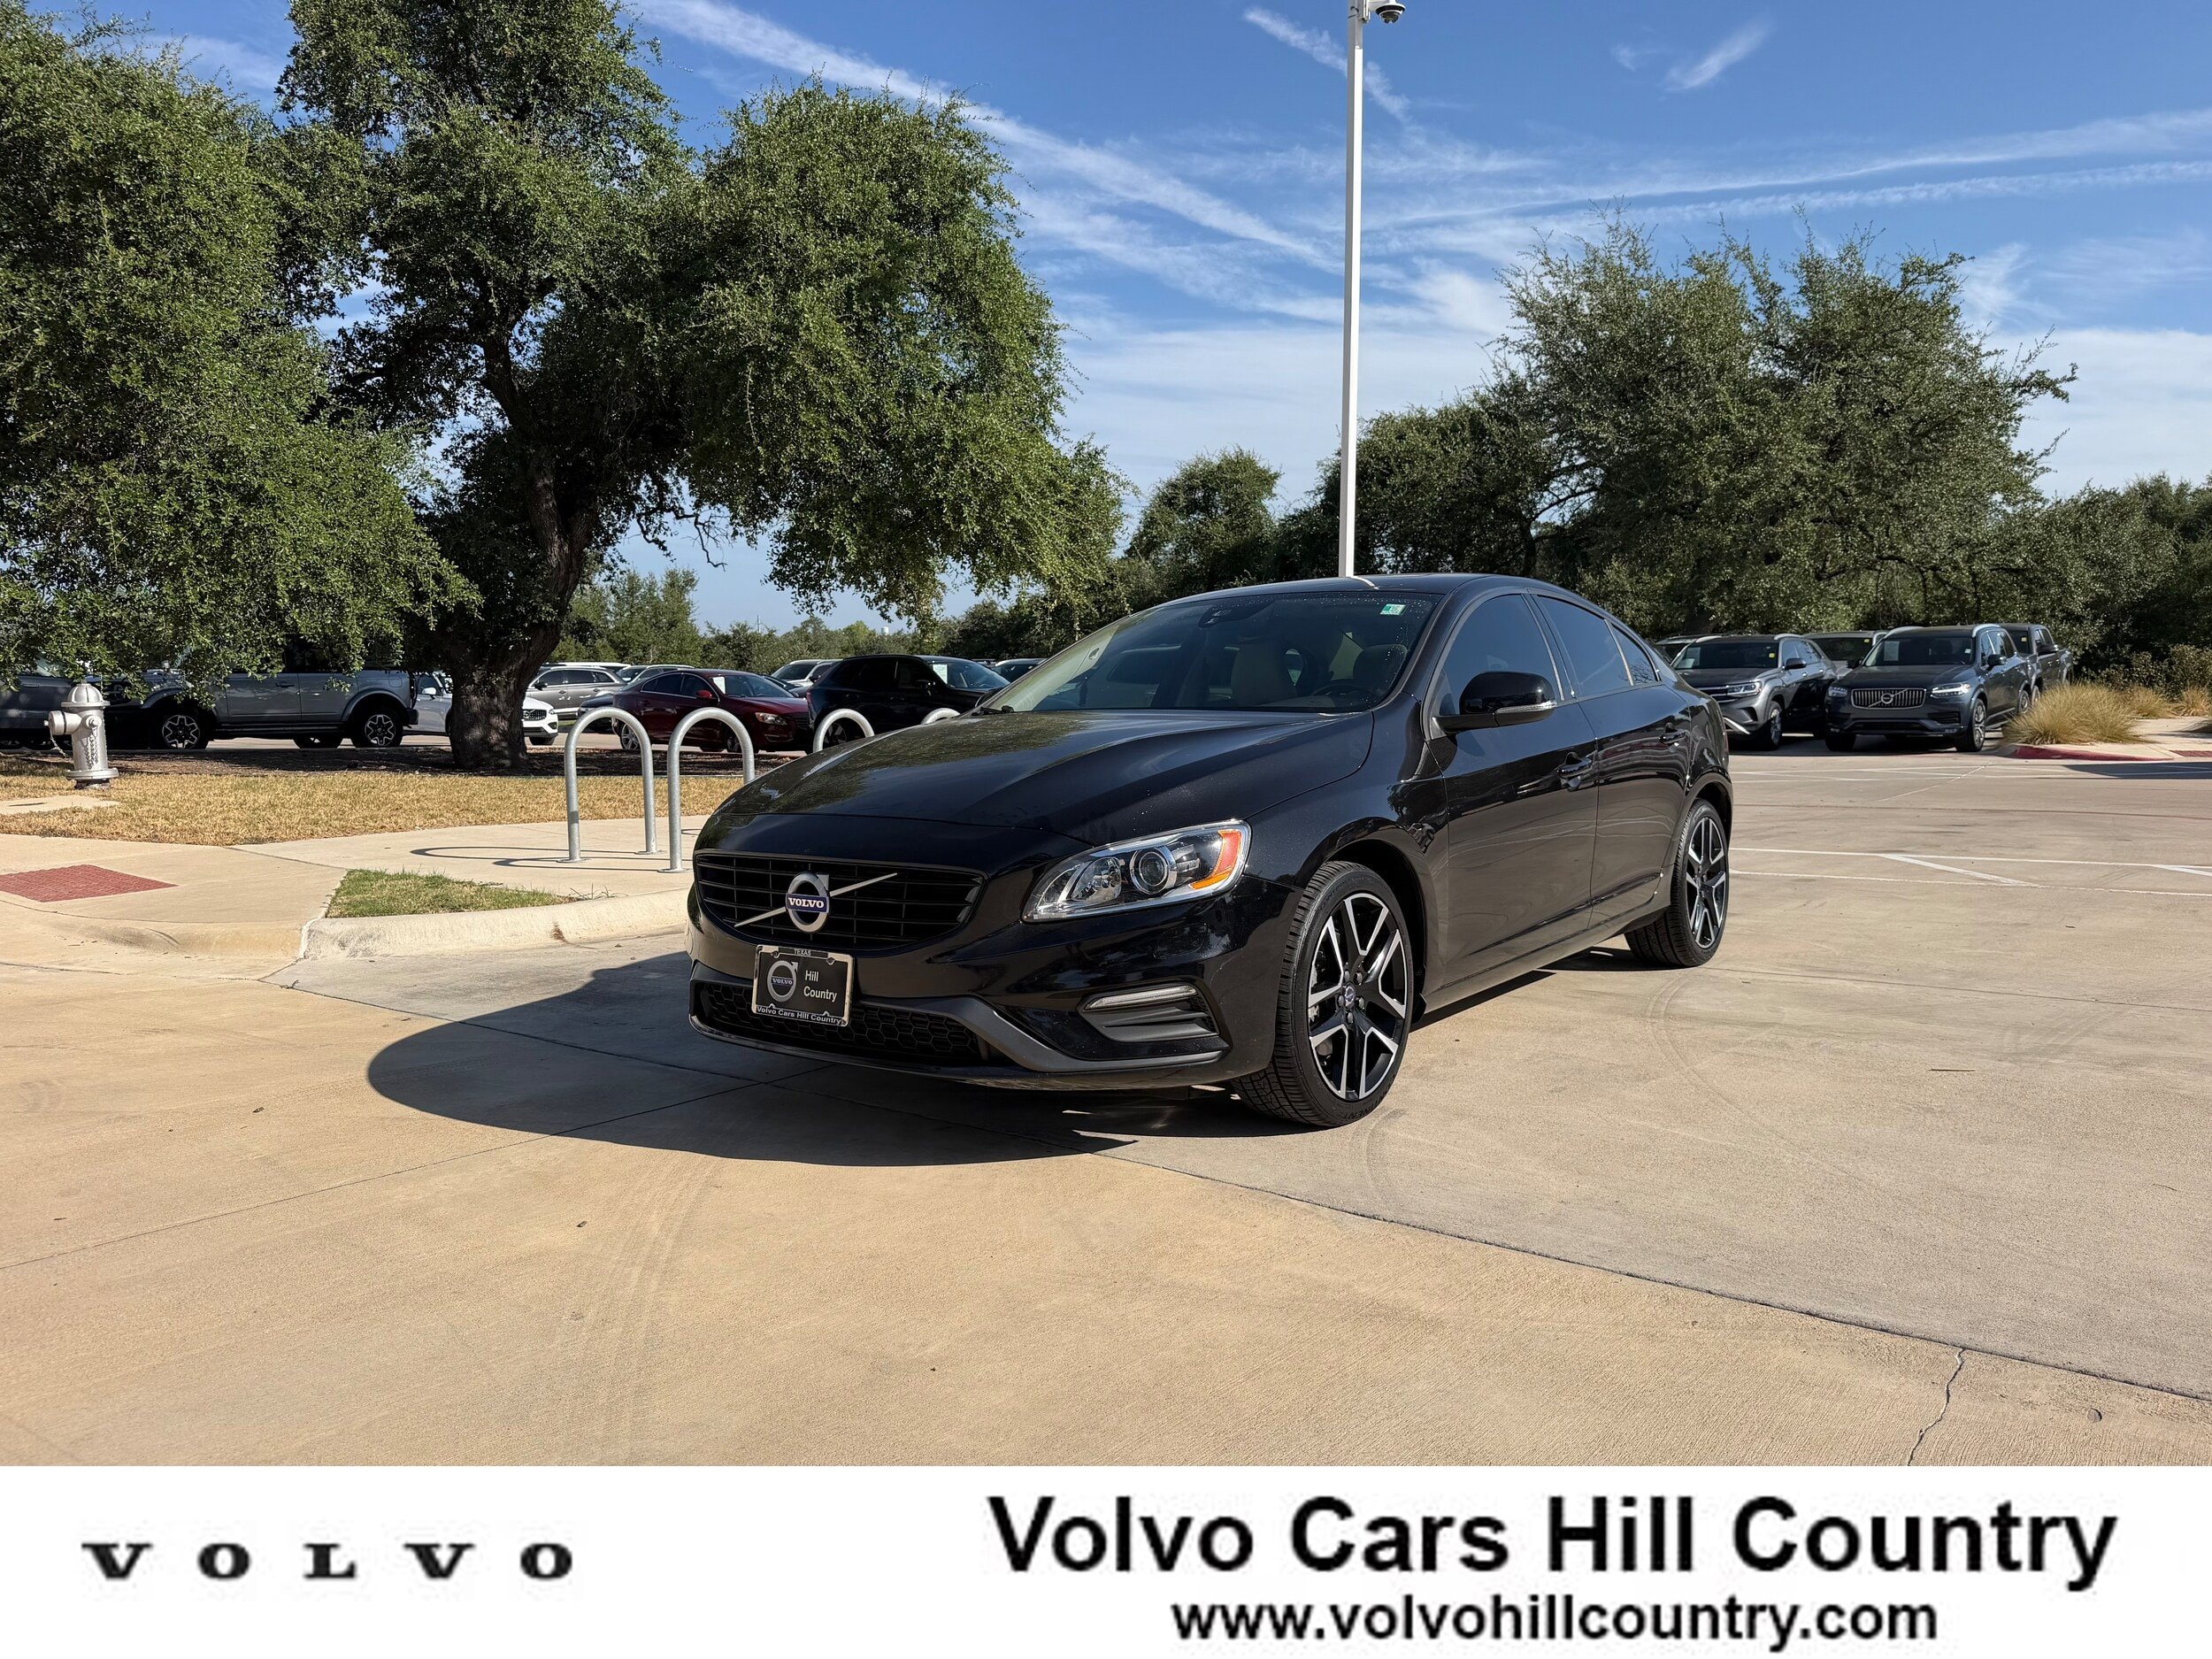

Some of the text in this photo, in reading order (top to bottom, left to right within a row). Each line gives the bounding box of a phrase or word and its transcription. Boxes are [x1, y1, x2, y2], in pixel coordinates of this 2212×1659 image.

[788, 897, 825, 909] VOLVO
[805, 970, 819, 982] Hill
[803, 986, 838, 1002] Country
[757, 1005, 777, 1015] Volvo
[778, 1010, 795, 1018] Cars
[810, 1014, 842, 1025] Country
